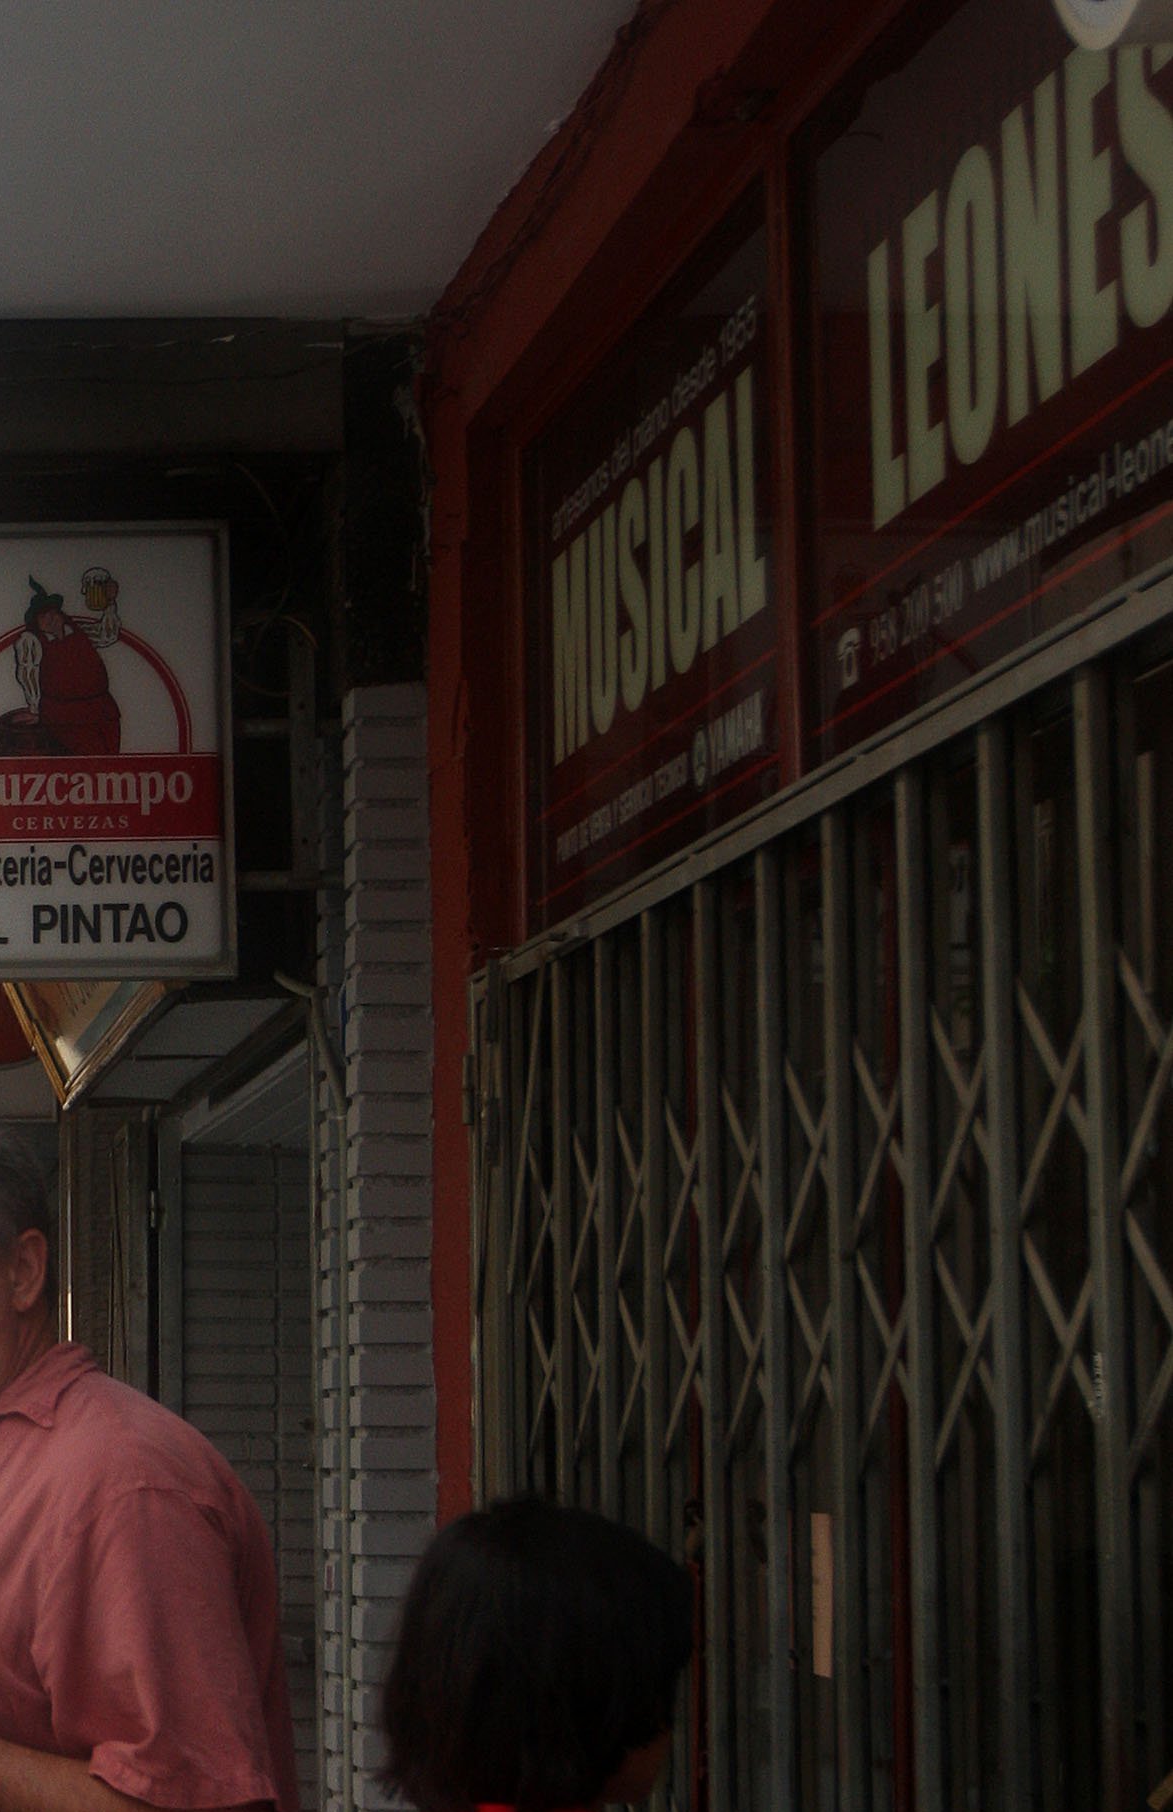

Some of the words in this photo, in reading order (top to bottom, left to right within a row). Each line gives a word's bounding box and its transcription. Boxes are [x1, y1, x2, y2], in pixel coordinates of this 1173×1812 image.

[868, 42, 1173, 534] LEONES
[553, 364, 767, 769] MUSICAL
[12, 815, 130, 831] CERVEZAS
[32, 901, 189, 943] PINTAO
